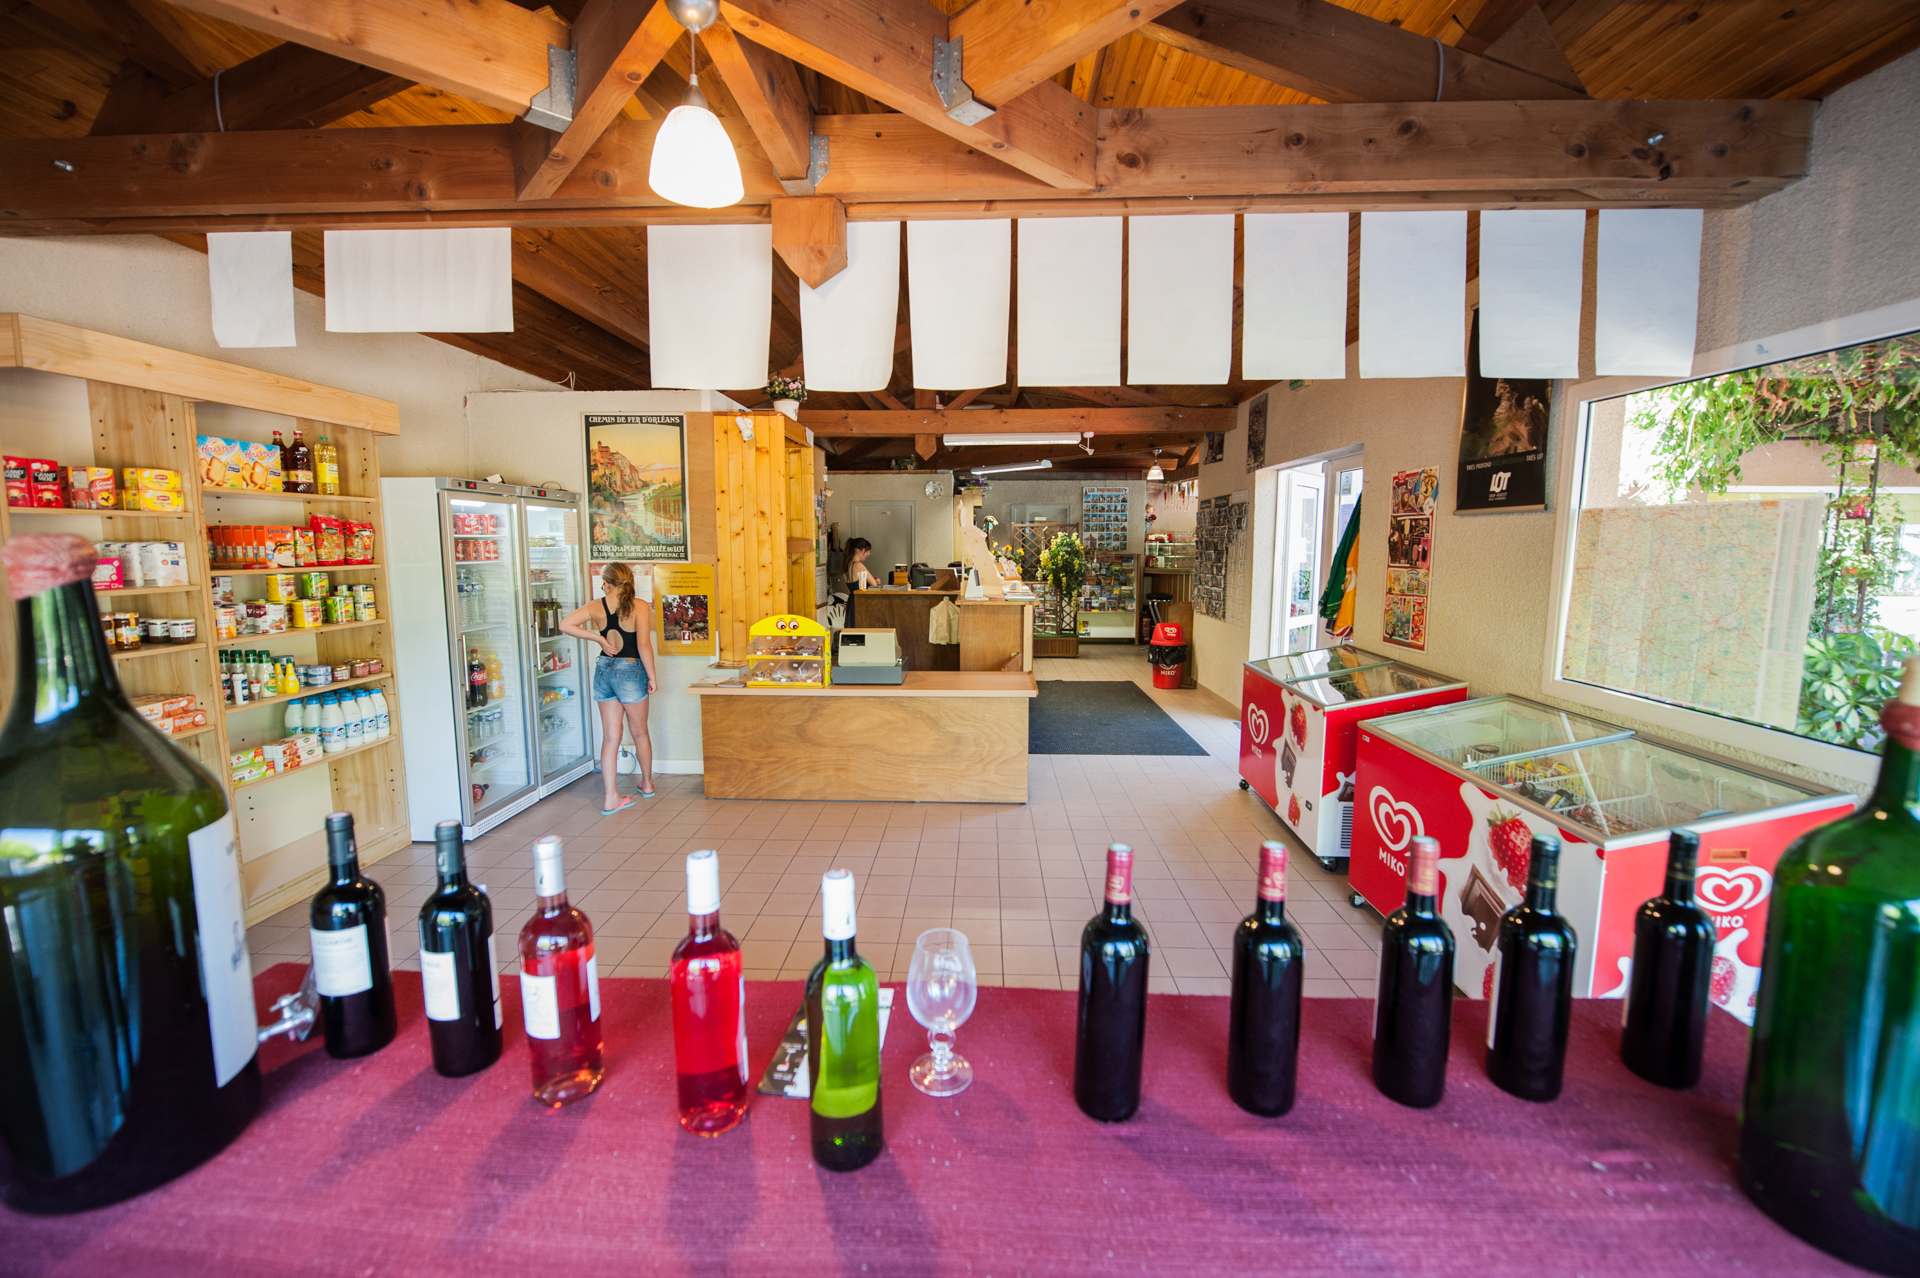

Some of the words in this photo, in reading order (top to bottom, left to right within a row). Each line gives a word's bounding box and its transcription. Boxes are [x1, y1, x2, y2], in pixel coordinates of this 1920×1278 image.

[627, 416, 641, 424] FER
[200, 442, 235, 456] Heudebert
[244, 449, 276, 461] Heudebert
[1489, 471, 1512, 493] LOT
[1251, 743, 1262, 759] MIKO
[1379, 847, 1405, 877] MIKO
